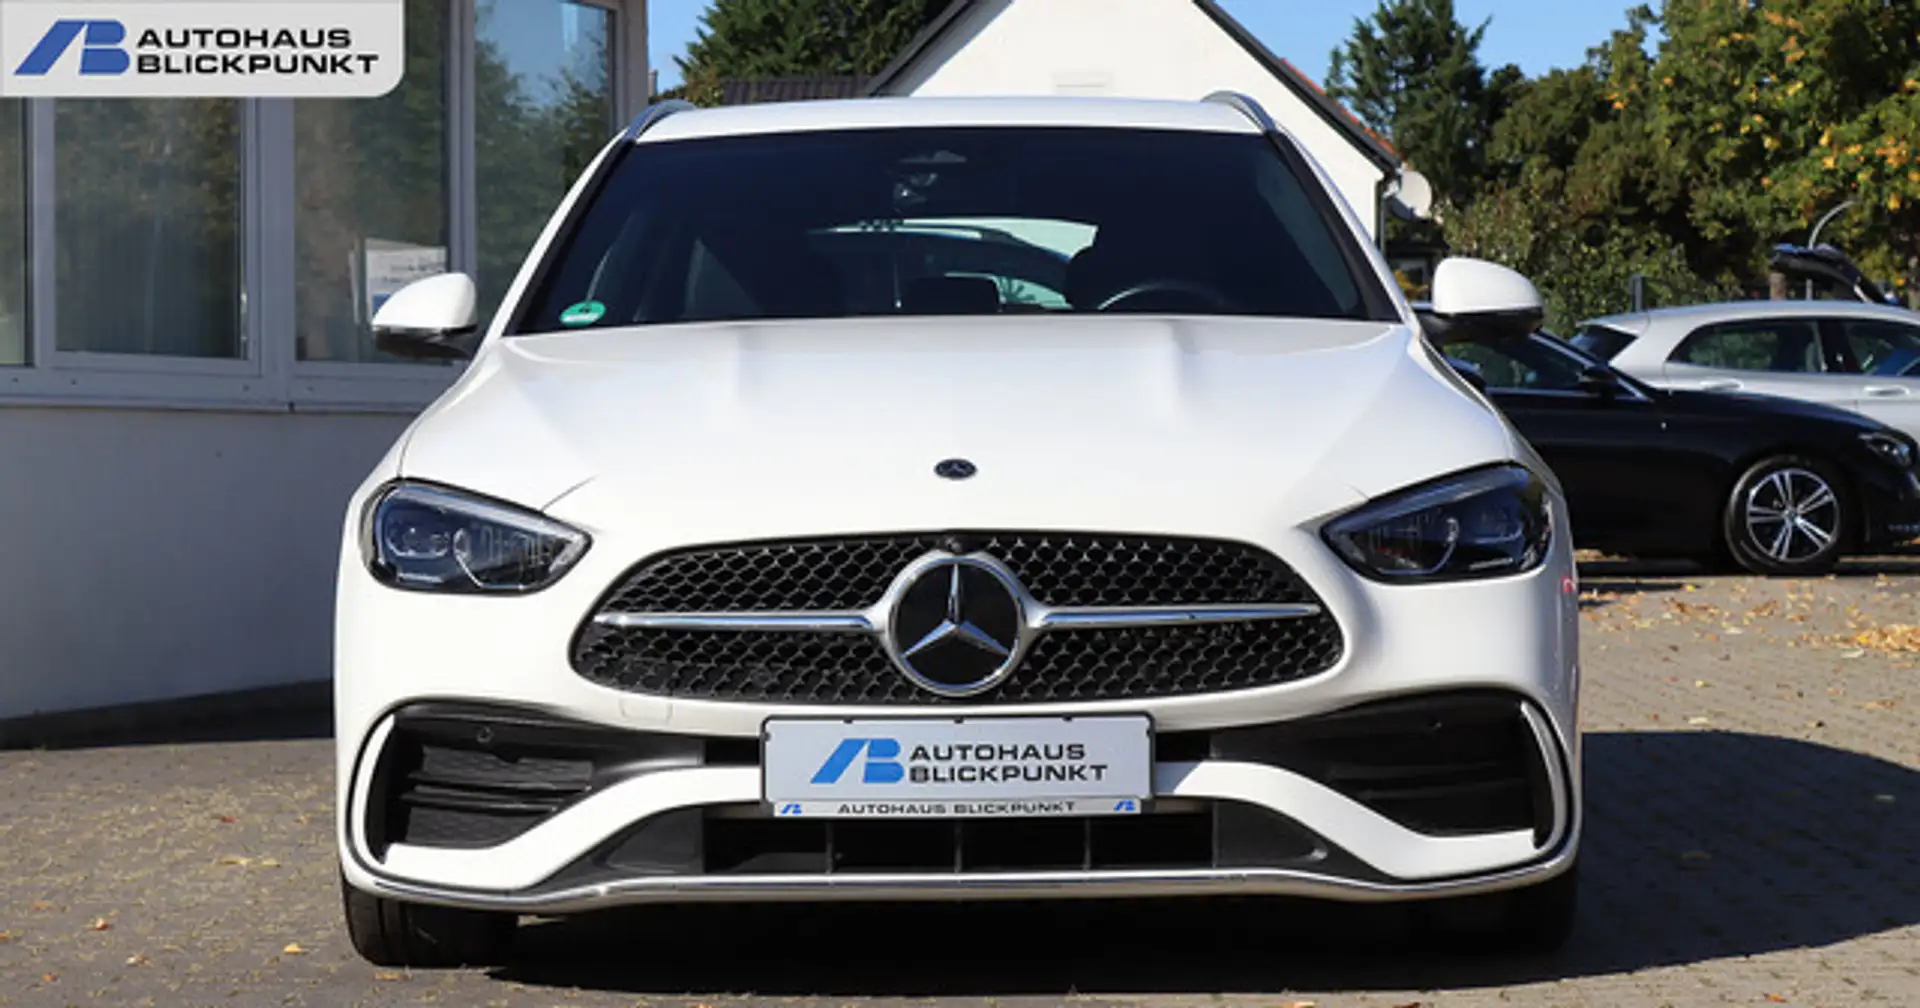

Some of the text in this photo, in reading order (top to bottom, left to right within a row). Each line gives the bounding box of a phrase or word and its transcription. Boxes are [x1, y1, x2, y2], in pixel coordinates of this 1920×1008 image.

[910, 744, 1086, 761] AUTOHAUS
[909, 765, 1108, 783] BLICKPUNKT
[838, 803, 948, 814] AUTOHAUS
[954, 802, 1076, 814] BLICKPUNKT
